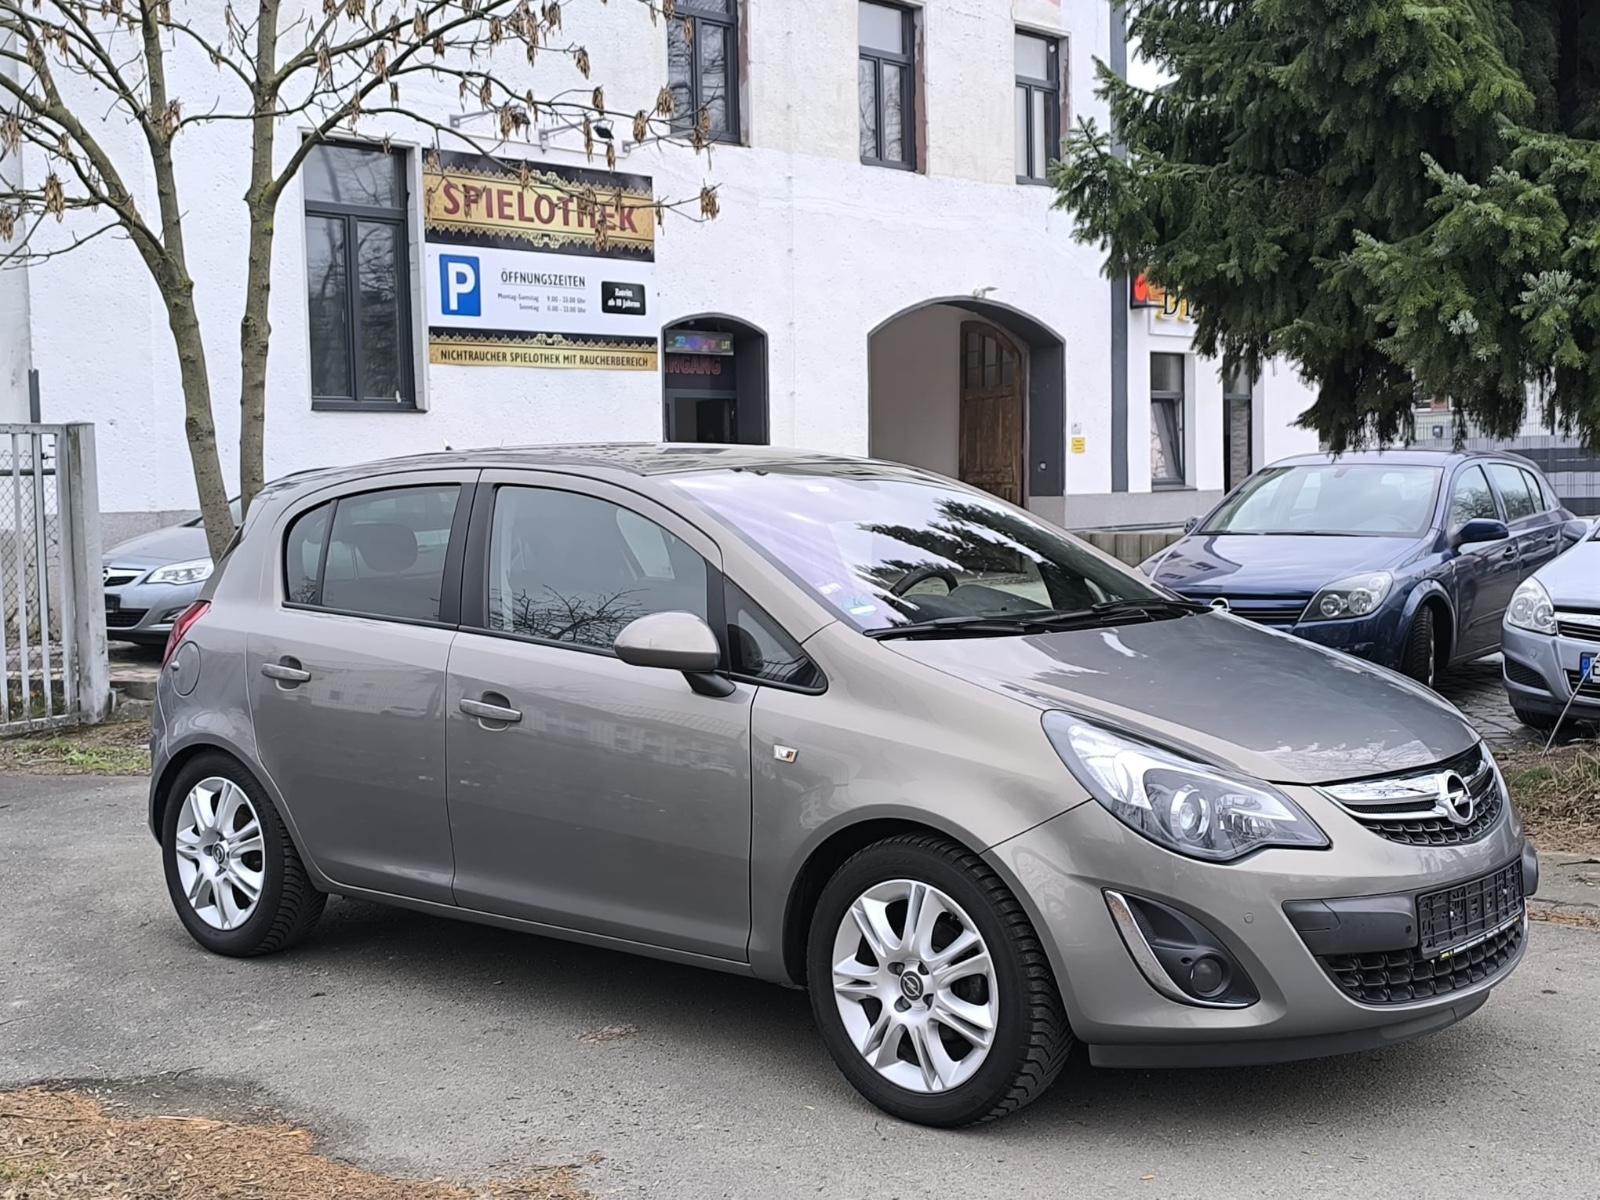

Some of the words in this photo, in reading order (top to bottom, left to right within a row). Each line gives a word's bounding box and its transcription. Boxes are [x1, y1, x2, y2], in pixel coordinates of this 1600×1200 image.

[443, 182, 639, 233] SPIELOTHEK
[447, 262, 476, 311] P
[501, 269, 586, 287] ÖFFNUNGSZEITEN
[440, 349, 508, 362] NICHTRAUCHER
[509, 351, 561, 364] SPIELOTHEK
[562, 353, 577, 365] MIT
[579, 354, 649, 367] RAUCHERBEREICH
